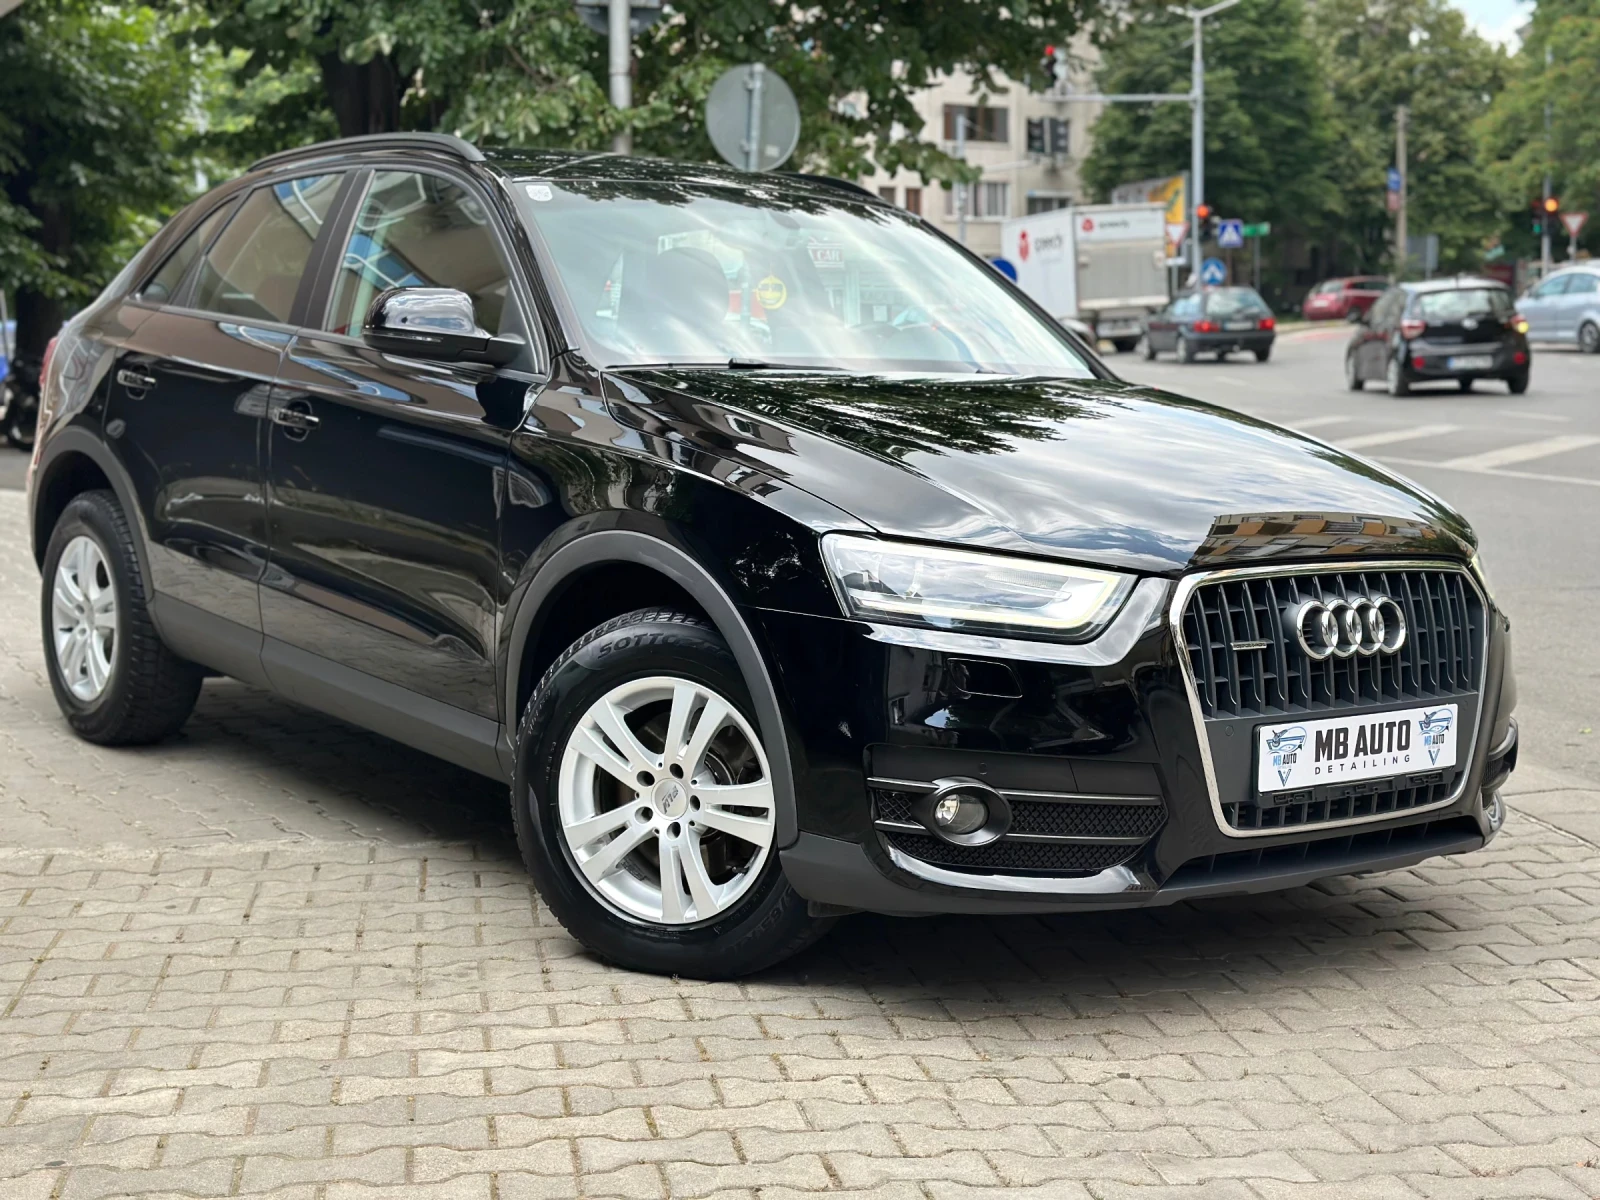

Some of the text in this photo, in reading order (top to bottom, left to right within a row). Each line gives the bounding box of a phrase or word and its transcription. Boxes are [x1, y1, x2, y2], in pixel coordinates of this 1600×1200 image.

[1314, 719, 1411, 763] MB AUTO
[1432, 733, 1445, 745] AUTO
[1272, 754, 1282, 767] MB
[1282, 752, 1297, 766] AUTO
[1314, 754, 1410, 775] DETAILING
